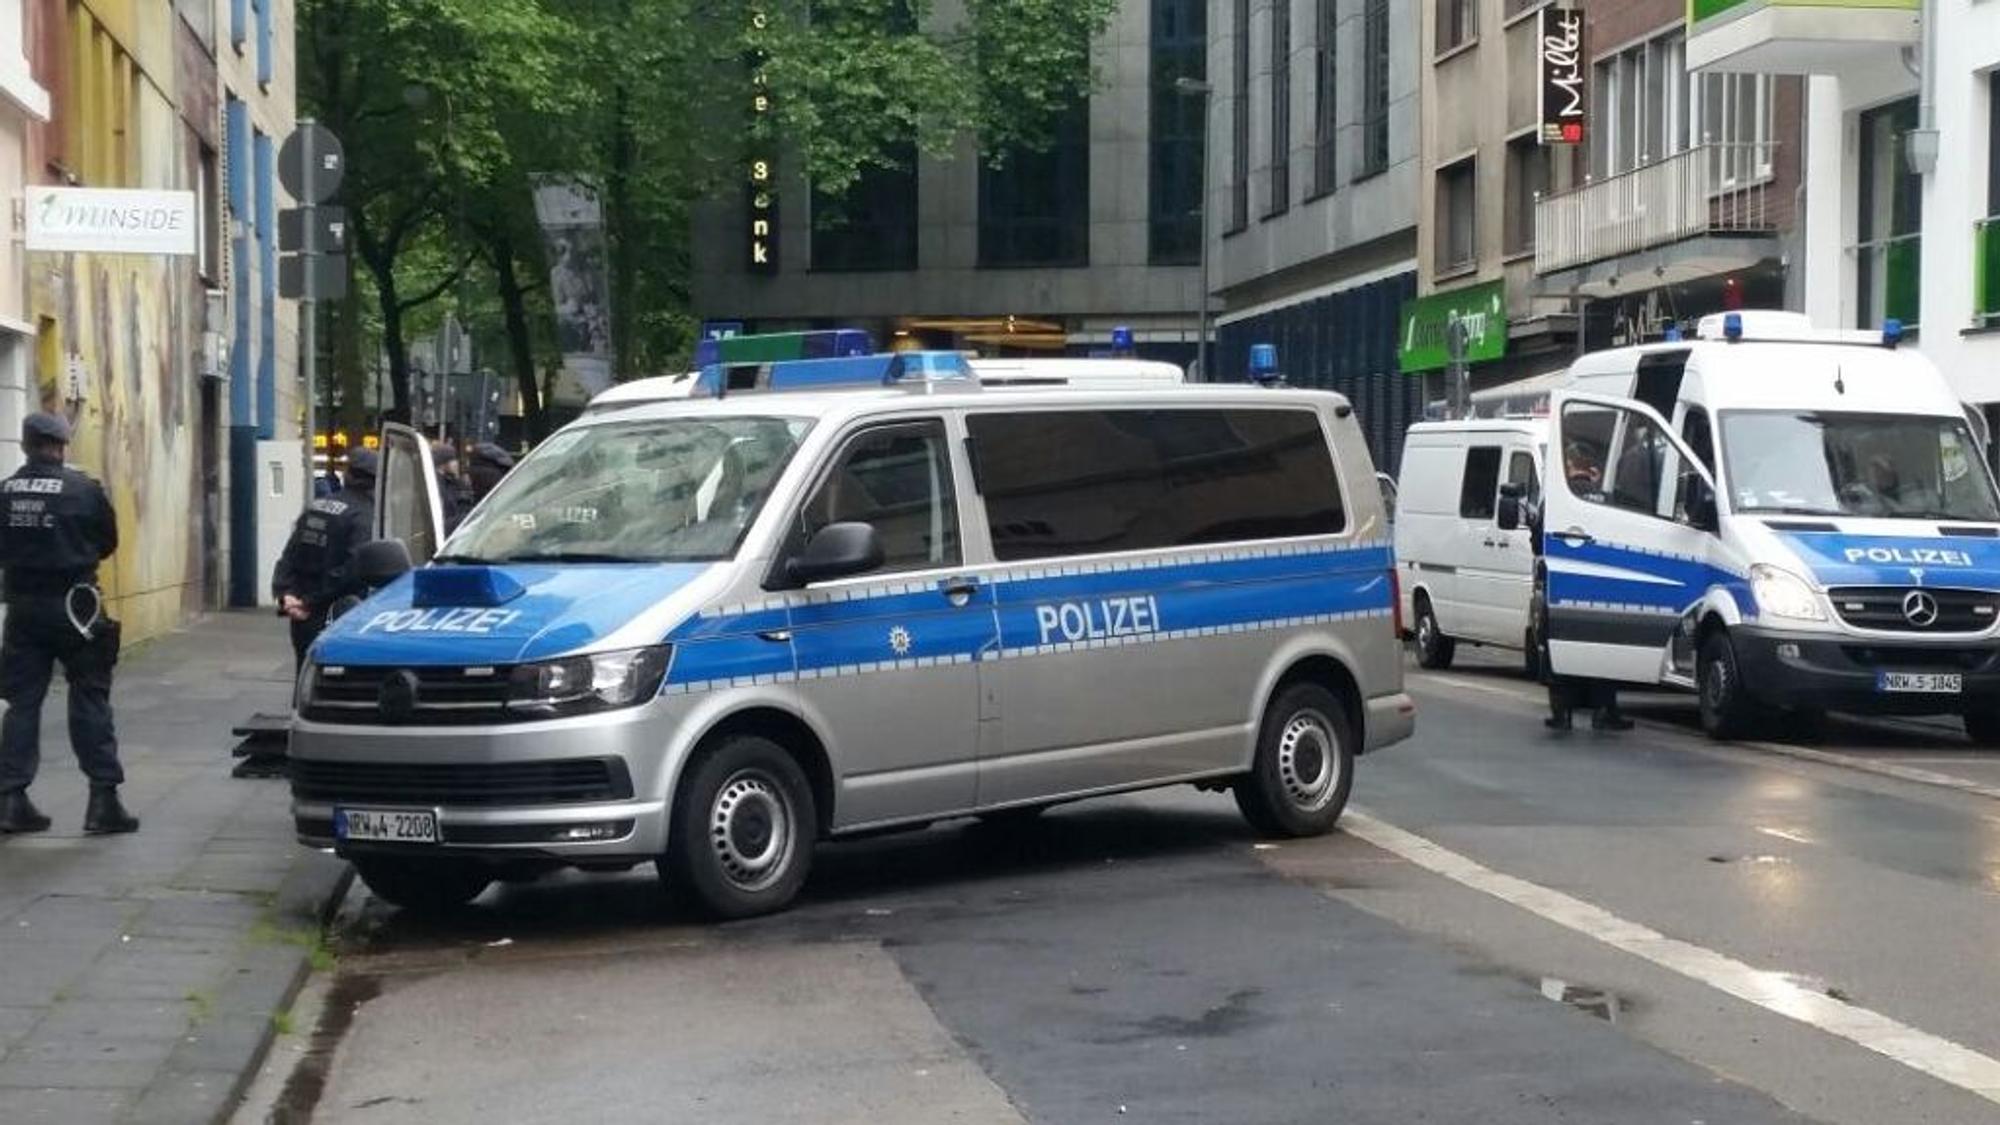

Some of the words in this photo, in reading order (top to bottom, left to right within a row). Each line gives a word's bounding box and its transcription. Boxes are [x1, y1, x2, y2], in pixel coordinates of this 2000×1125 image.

[4, 478, 63, 493] POLIZEI
[1844, 547, 1974, 566] POLIZEI
[359, 606, 521, 635] POLIZEI
[1036, 595, 1160, 644] POLIZEI
